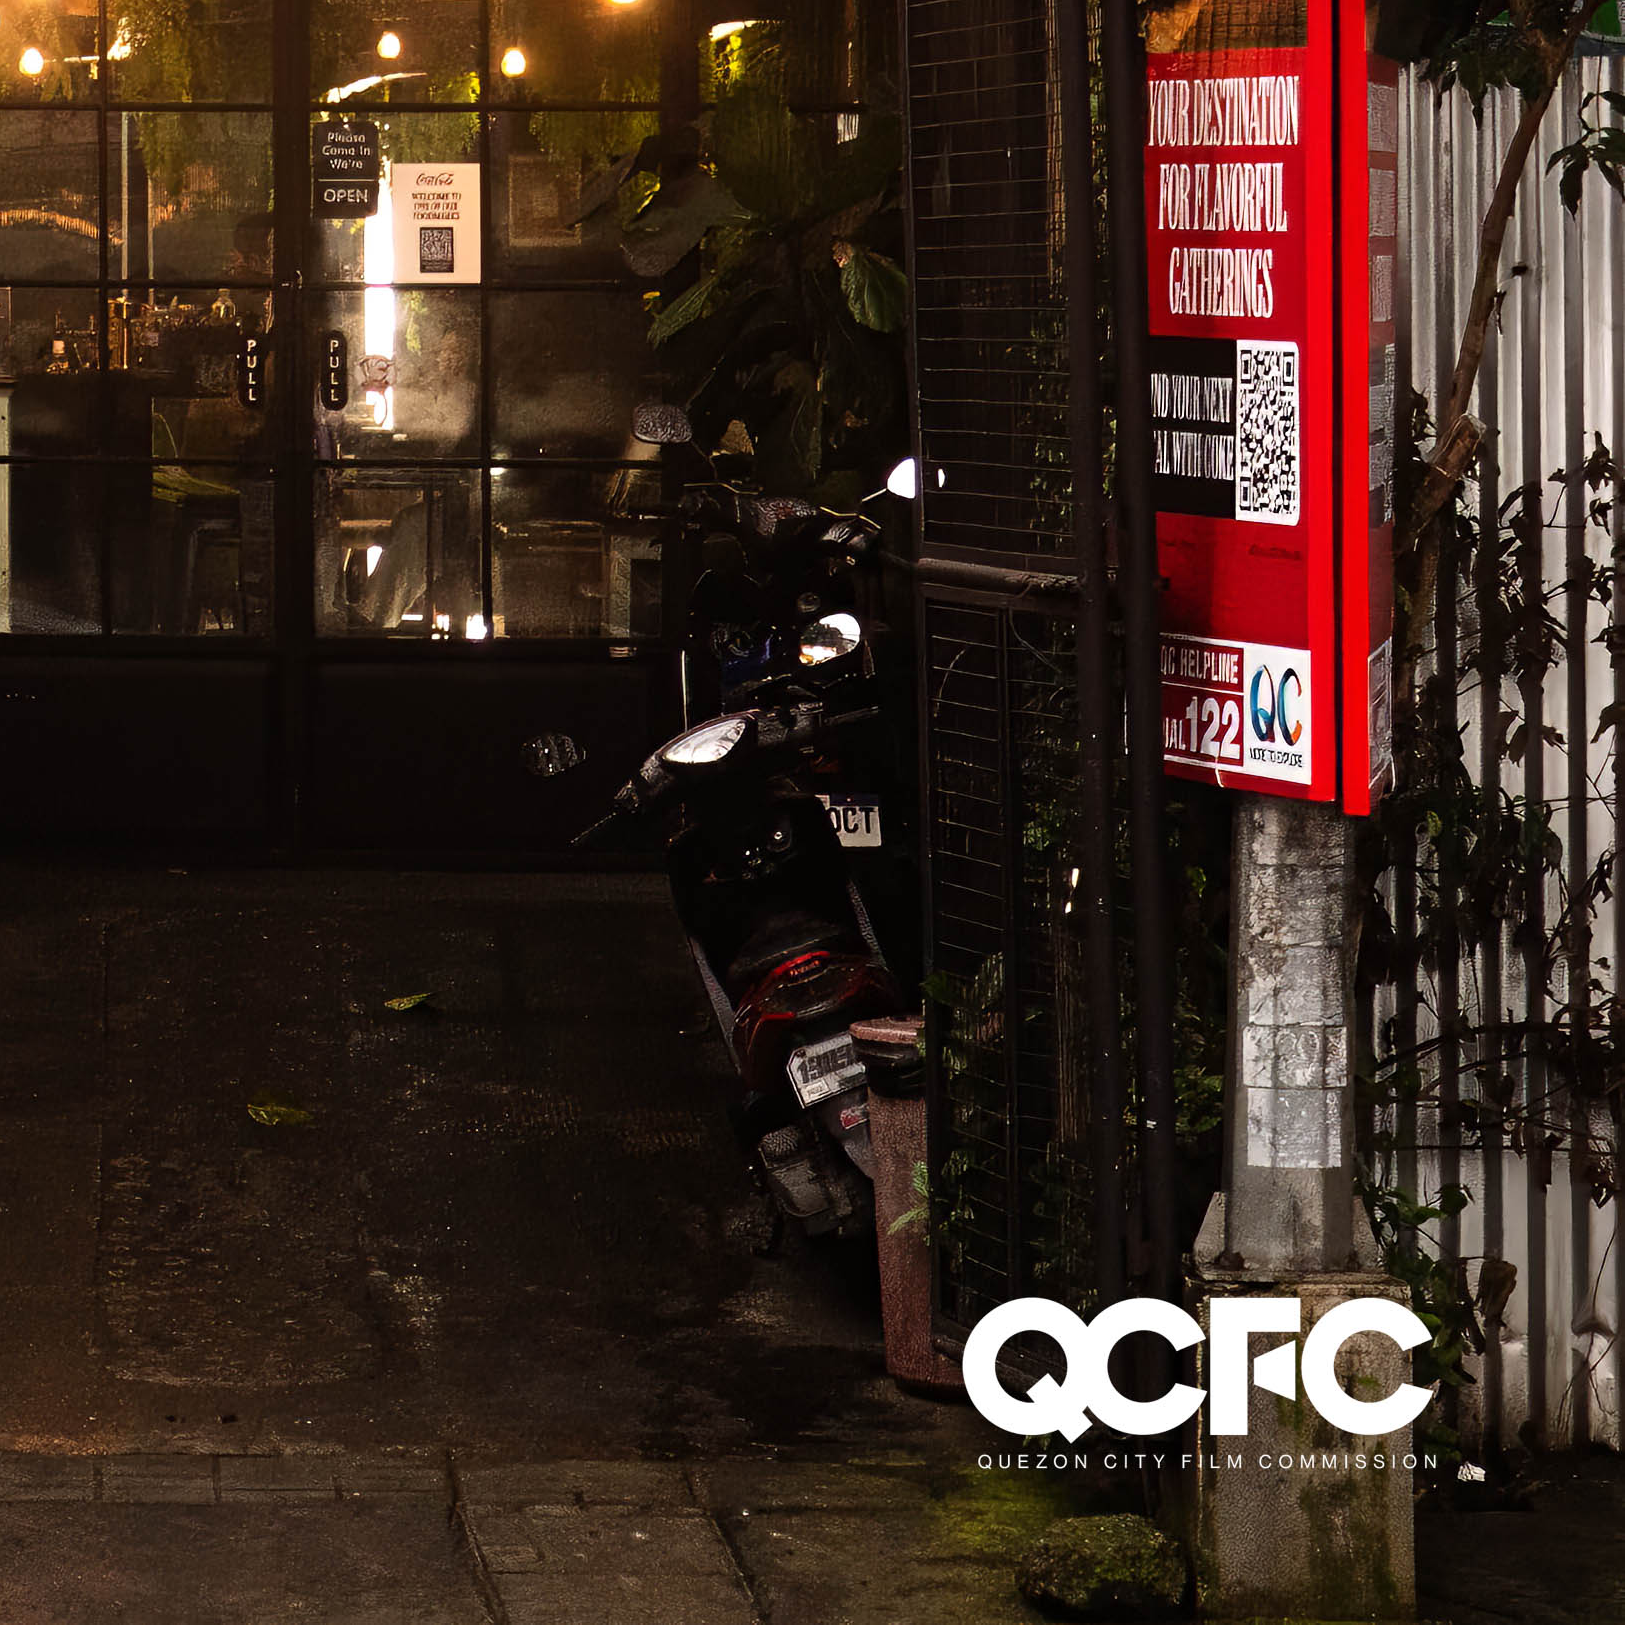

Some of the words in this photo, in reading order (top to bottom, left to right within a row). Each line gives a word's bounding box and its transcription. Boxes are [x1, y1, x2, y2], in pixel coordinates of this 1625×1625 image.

[1148, 80, 1190, 146] YOUR
[1192, 76, 1299, 146] DESTINATION
[324, 189, 368, 203] OPEN
[1158, 164, 1190, 230] FOR
[1191, 163, 1287, 232] FLAVORFUL
[1169, 247, 1274, 318] GATHERINGS
[247, 339, 257, 401] PULL
[330, 340, 339, 402] PULL
[1172, 375, 1200, 420] YOUR
[1203, 377, 1233, 423] NEXT
[1180, 648, 1239, 684] HELPLINE
[1163, 717, 1186, 750] IAL
[1186, 696, 1240, 760] 122
[1250, 664, 1302, 746] QC
